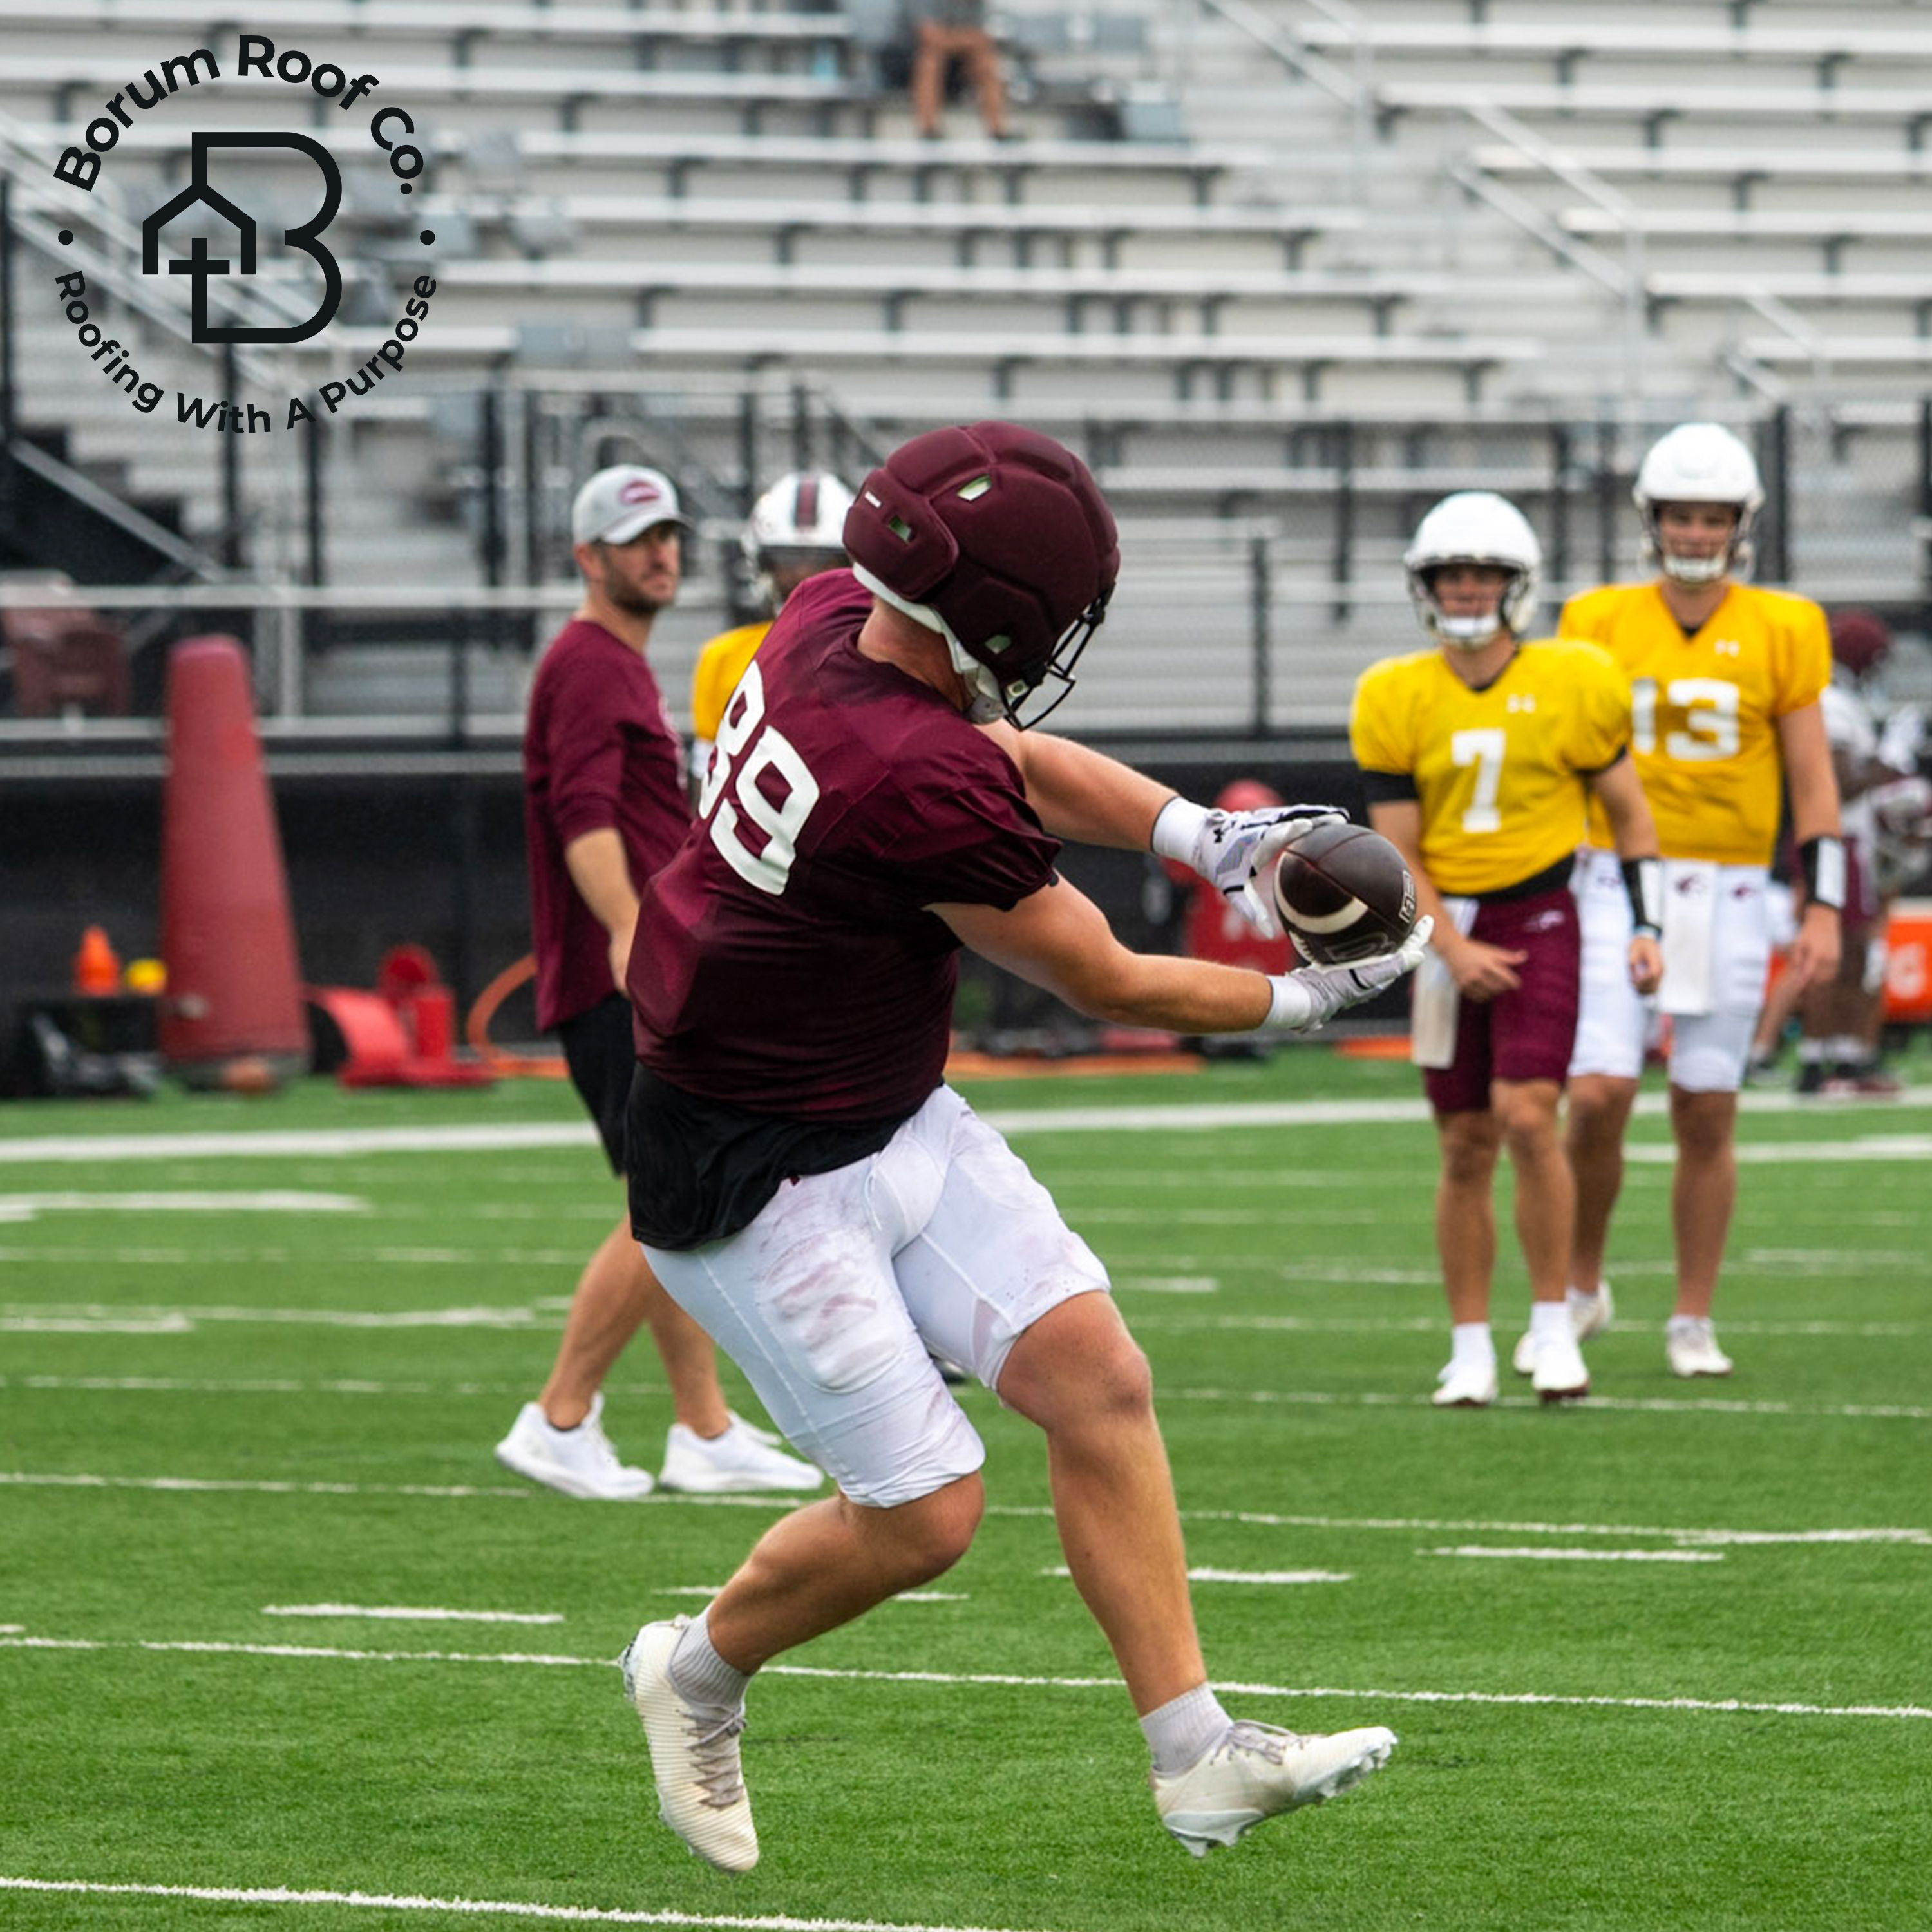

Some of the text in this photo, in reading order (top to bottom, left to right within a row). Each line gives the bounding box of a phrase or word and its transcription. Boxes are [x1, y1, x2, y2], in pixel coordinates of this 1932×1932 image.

[1629, 676, 1740, 762] 13
[699, 659, 820, 896] 89
[1450, 728, 1506, 834] 7
